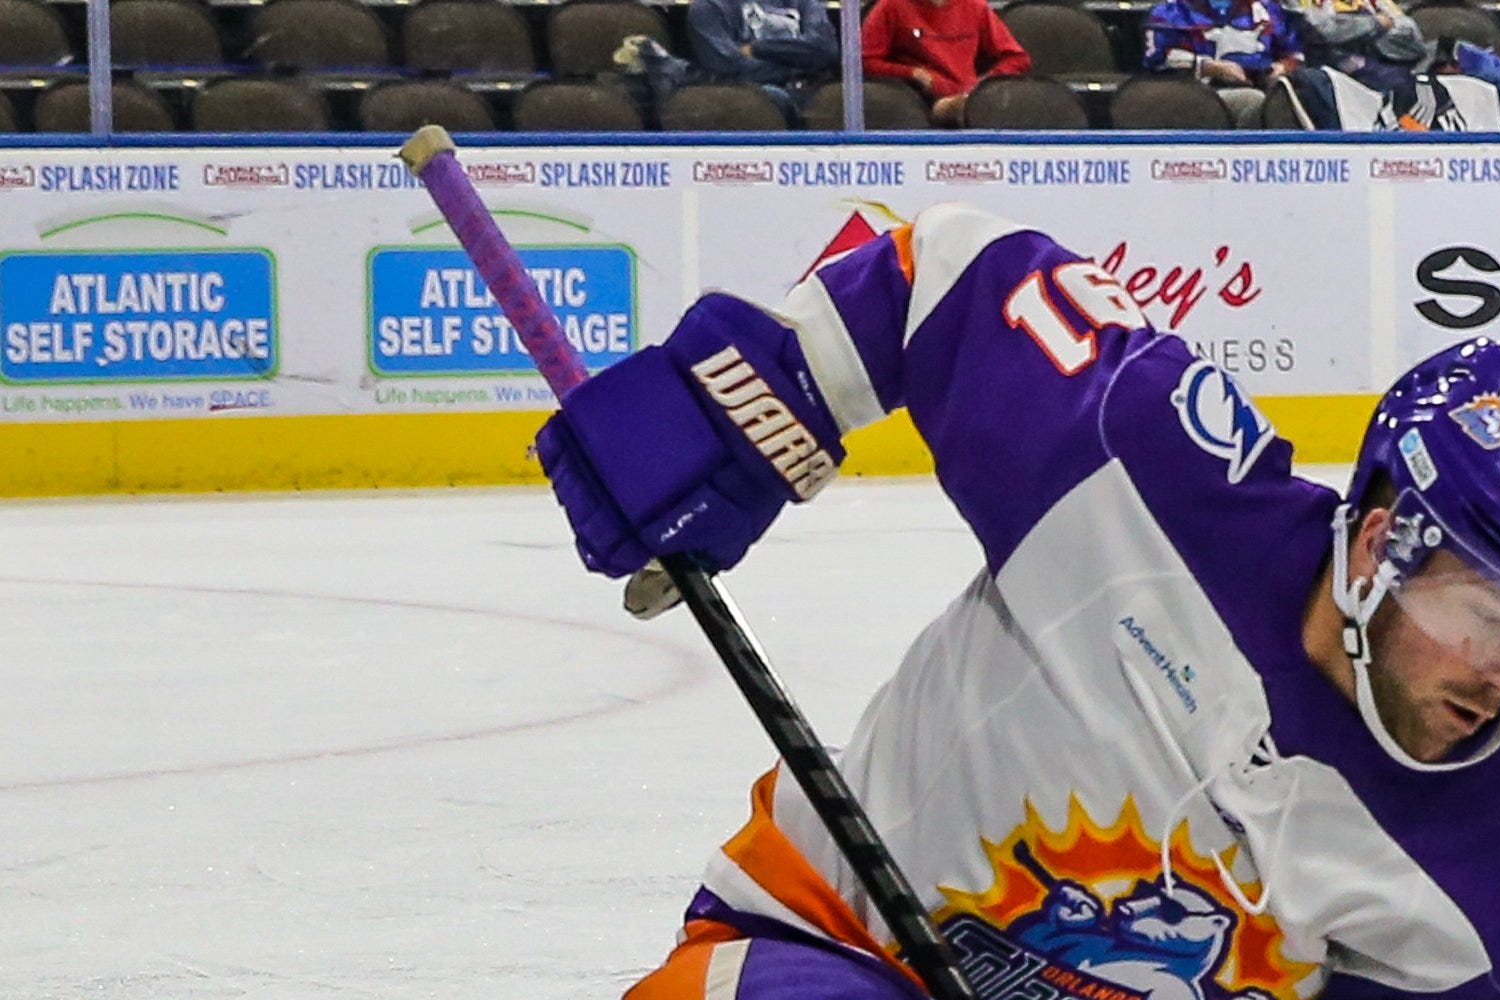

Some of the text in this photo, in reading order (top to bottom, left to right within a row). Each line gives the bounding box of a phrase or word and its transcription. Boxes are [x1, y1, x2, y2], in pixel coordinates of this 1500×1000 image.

[41, 165, 121, 190] SPLASH
[127, 164, 180, 190] ZONE
[295, 163, 371, 189] SPLASH
[541, 162, 616, 188] SPLASH
[621, 162, 670, 187] ZONE
[778, 161, 850, 186] SPLASH
[857, 161, 904, 186] ZONE
[1009, 159, 1079, 185] SPLASH
[1084, 159, 1130, 184] ZONE
[1231, 158, 1300, 184] SPLASH
[1304, 158, 1350, 184] ZONE
[50, 272, 225, 315] ATLANTIC
[420, 267, 587, 309] ATLTIC
[6, 318, 269, 364] SELF STORAGE
[379, 314, 630, 356] SELF STAGE
[128, 395, 159, 411] We
[163, 393, 205, 410] have
[495, 386, 522, 402] We
